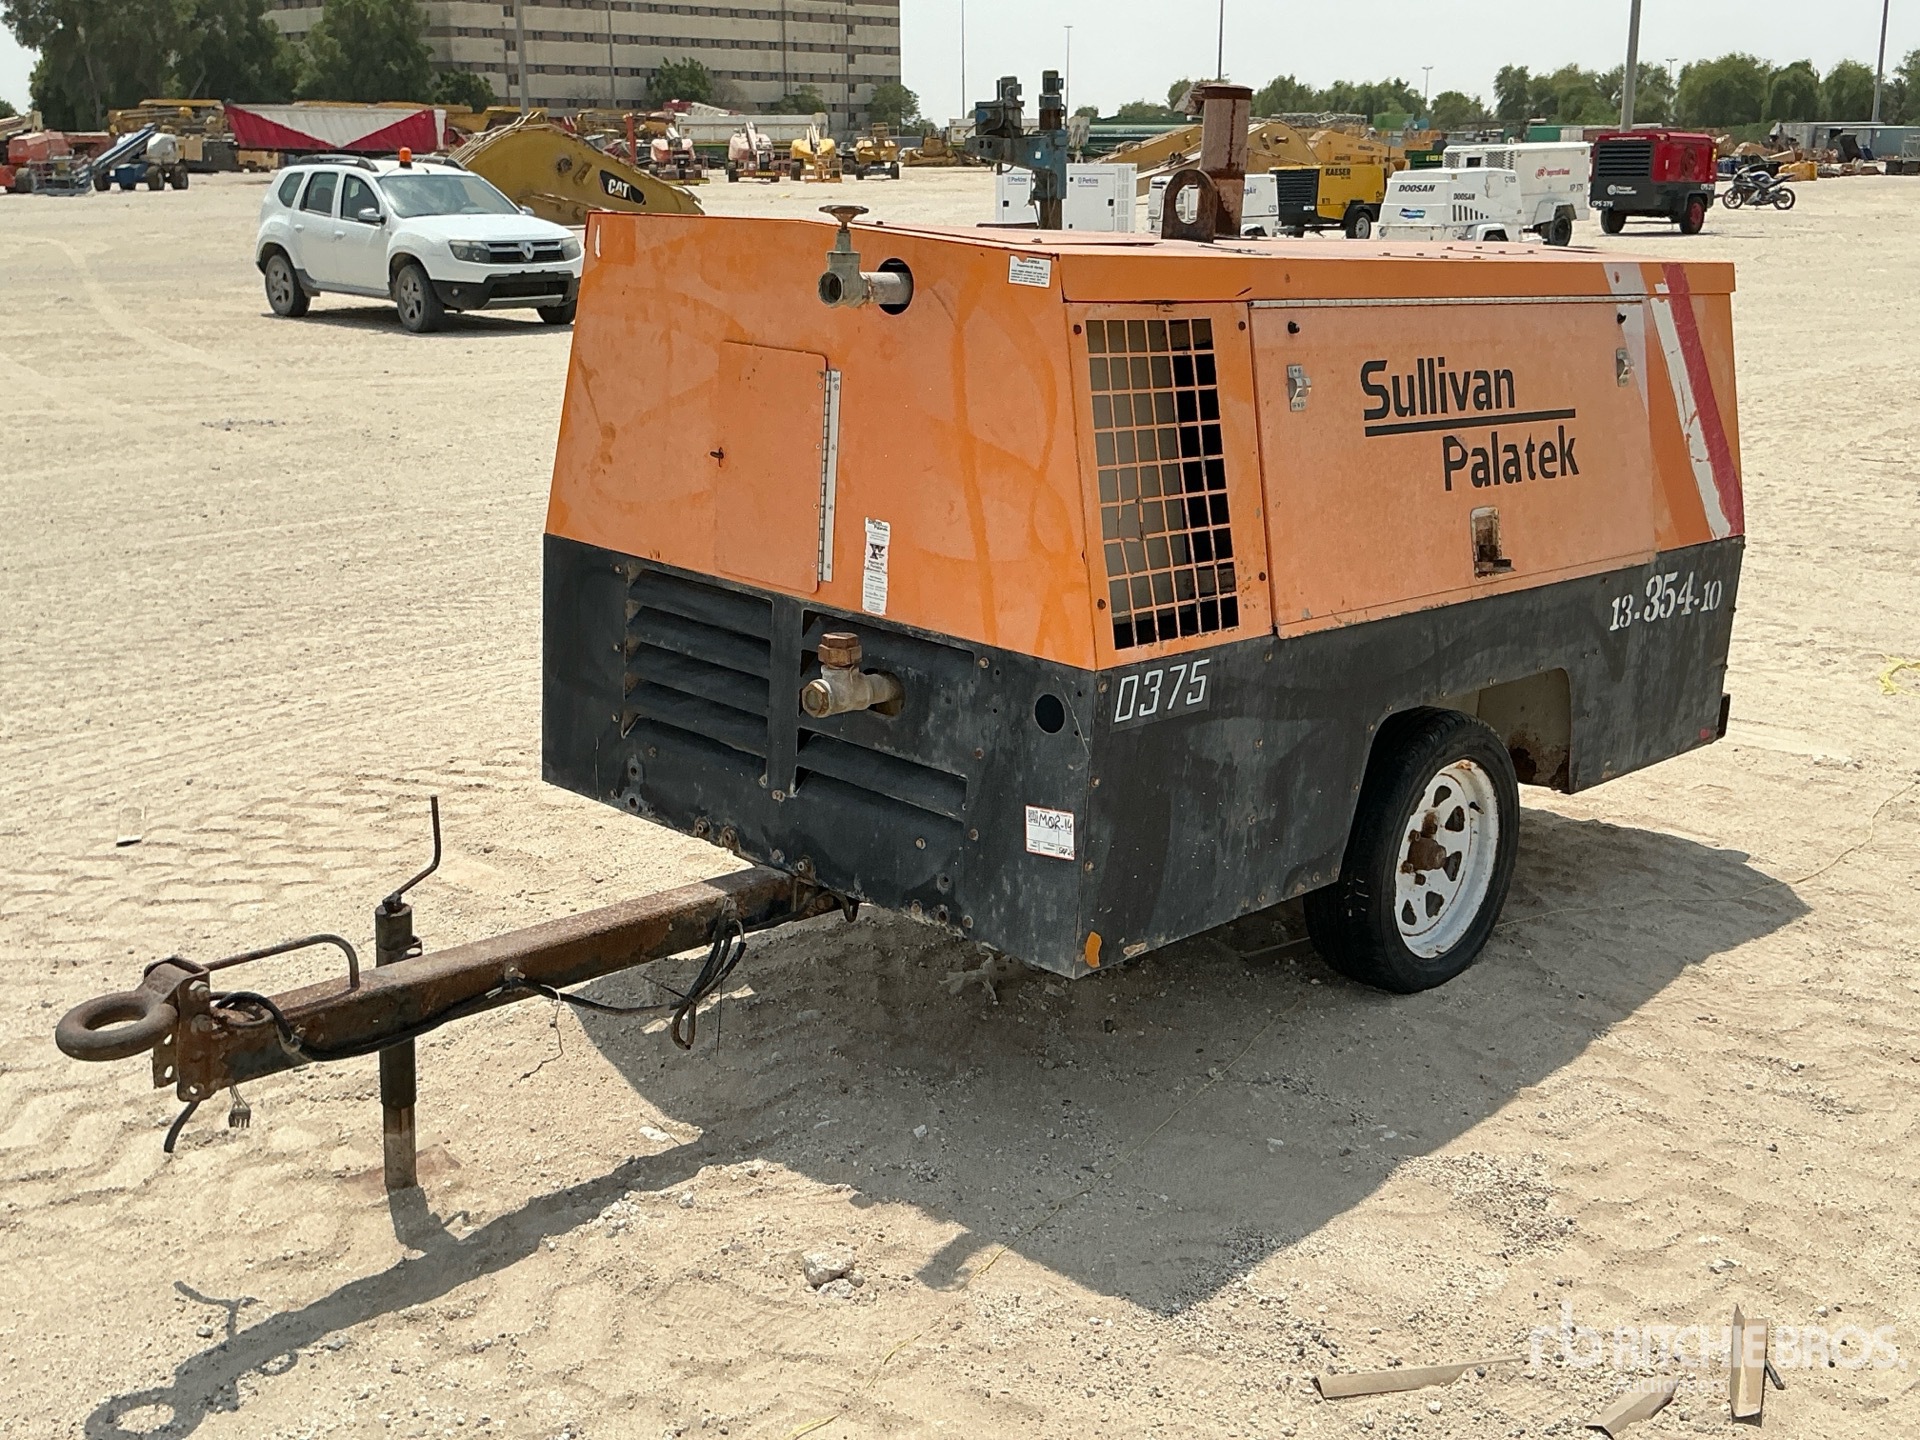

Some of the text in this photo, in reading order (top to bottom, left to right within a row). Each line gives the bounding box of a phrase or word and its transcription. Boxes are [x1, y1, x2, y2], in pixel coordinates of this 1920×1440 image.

[1325, 168, 1351, 176] KAESER
[608, 178, 630, 198] CAT
[1398, 184, 1436, 193] DOOSAN
[1453, 193, 1476, 201] DOOSAN
[1360, 356, 1515, 421] Sullivan
[1442, 425, 1580, 491] Palatek
